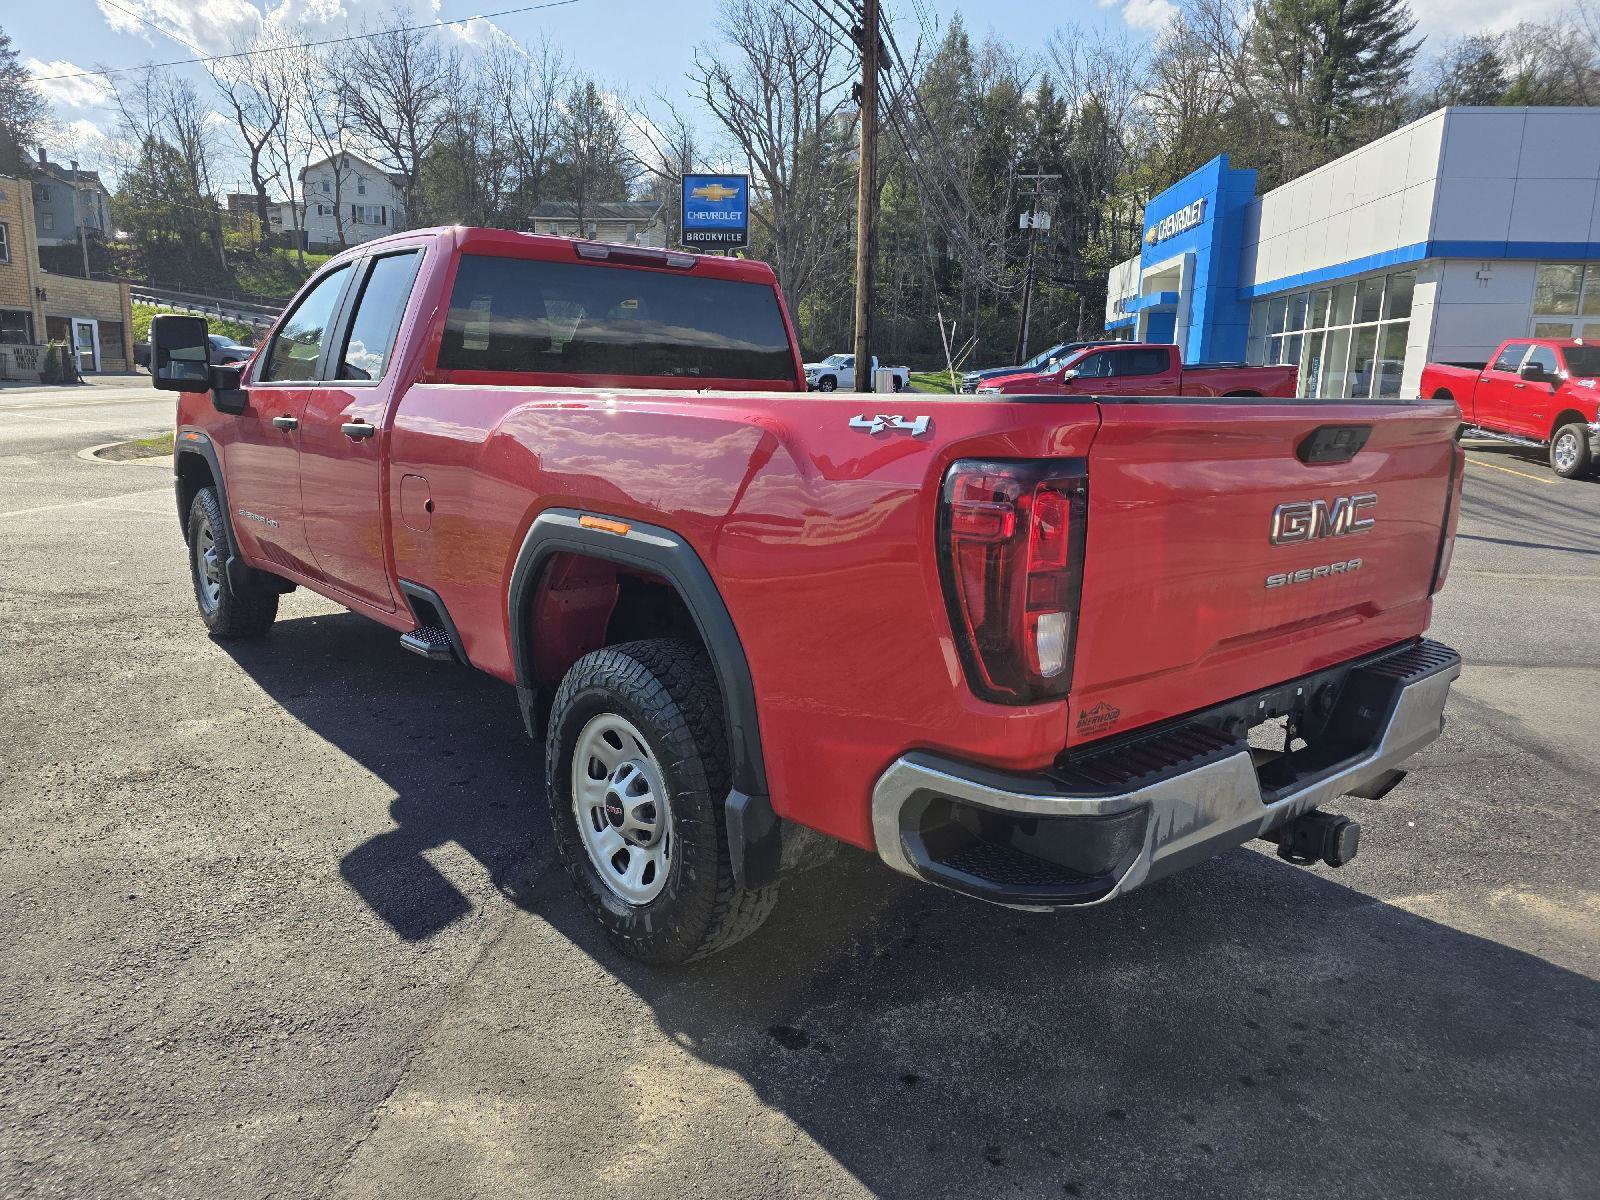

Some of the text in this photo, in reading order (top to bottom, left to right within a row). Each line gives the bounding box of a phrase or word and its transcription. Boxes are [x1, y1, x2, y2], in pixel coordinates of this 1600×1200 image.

[687, 211, 742, 220] CHEVROLET
[1158, 197, 1204, 241] CHEVROLET
[686, 232, 742, 241] BROOKVILLE
[239, 509, 279, 528] SIERRA HD
[1270, 491, 1378, 545] GMC
[1264, 558, 1363, 588] SIERRA
